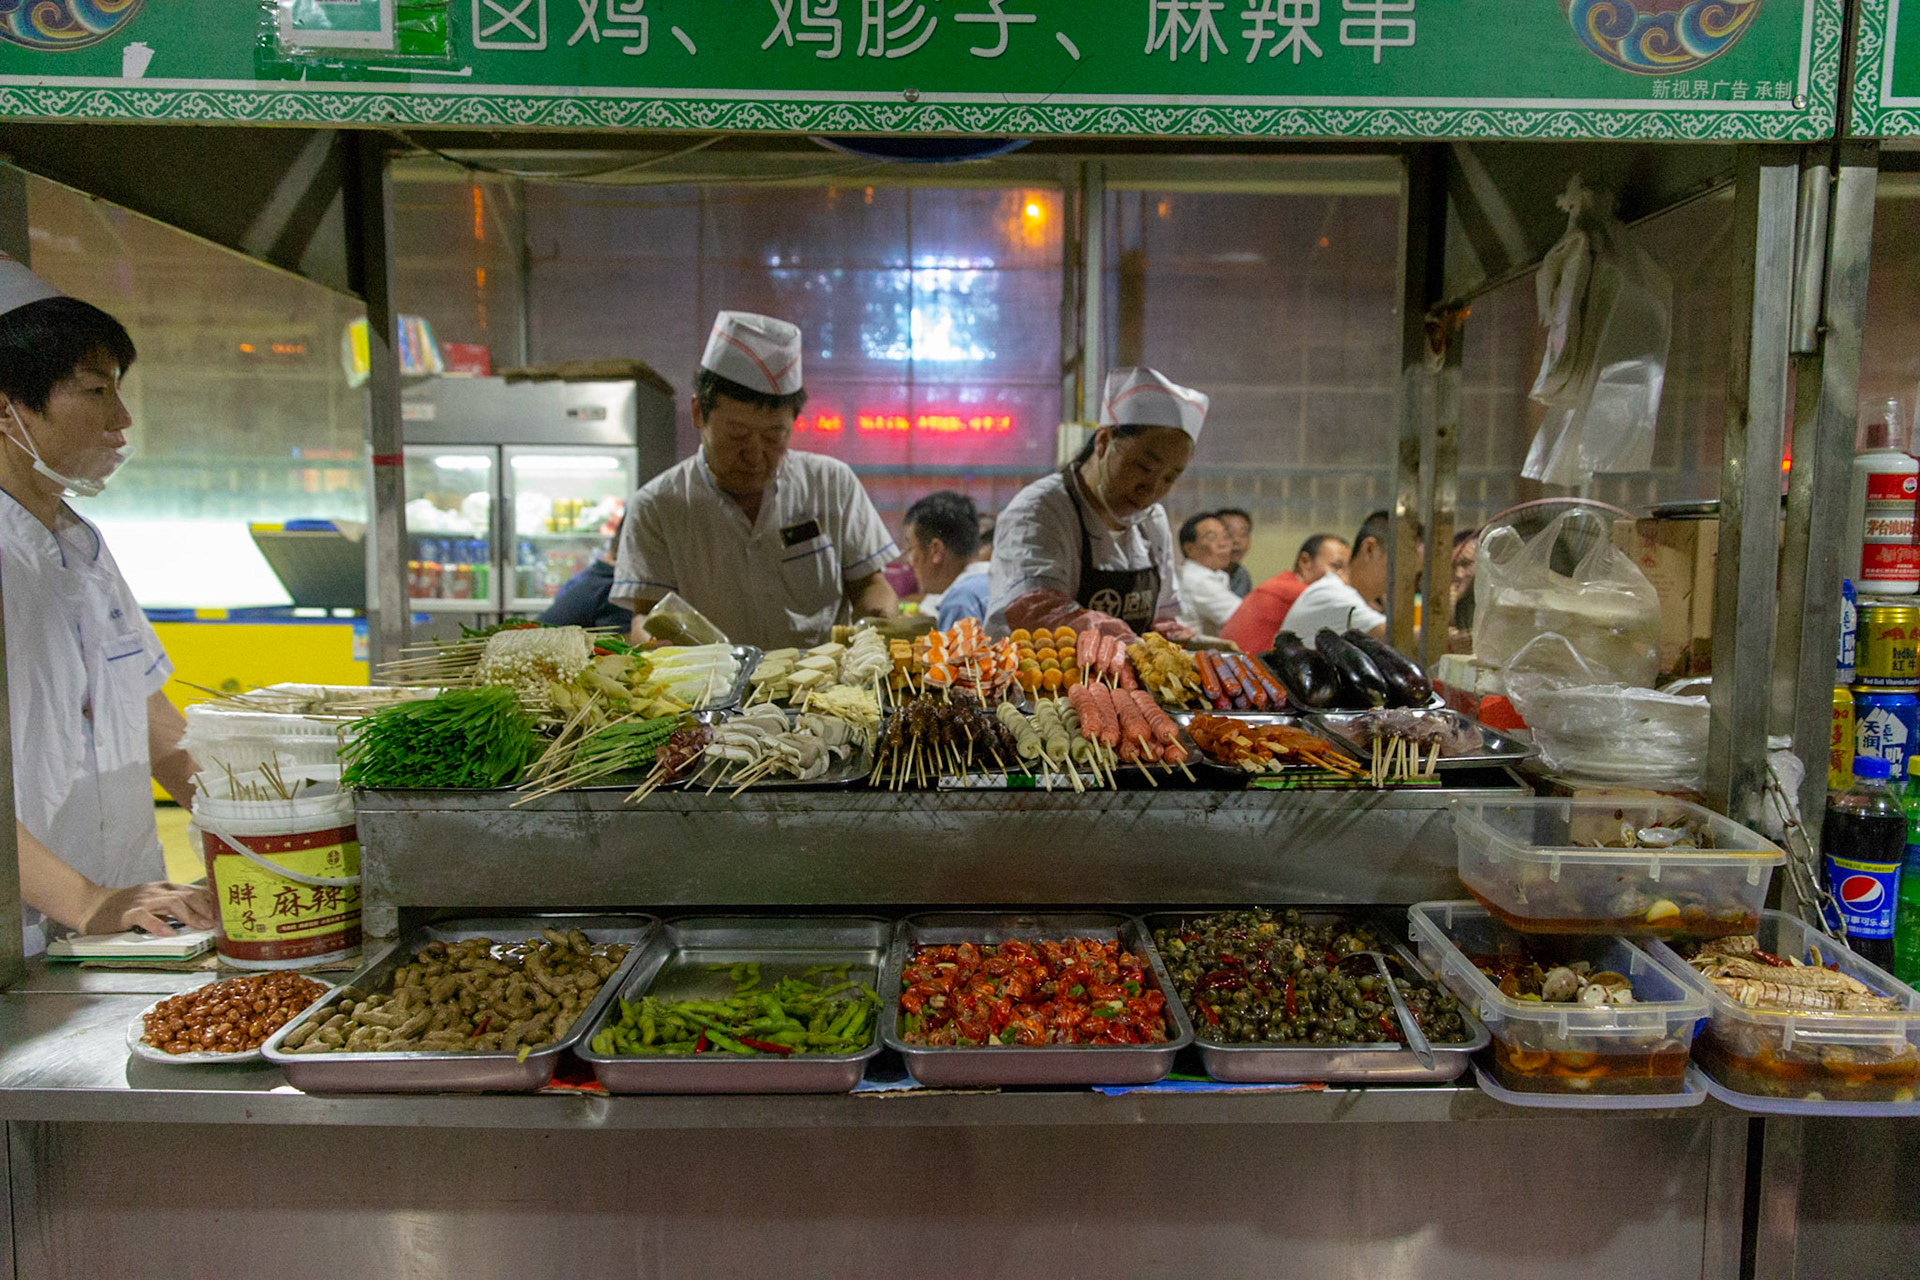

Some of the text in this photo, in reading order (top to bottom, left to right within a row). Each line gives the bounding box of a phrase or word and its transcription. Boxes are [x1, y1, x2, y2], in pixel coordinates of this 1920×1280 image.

[1652, 78, 1793, 100] 新视界广告 承制
[1892, 660, 1916, 671] 红牛
[1863, 721, 1881, 749] 天润
[229, 883, 257, 932] 胖子
